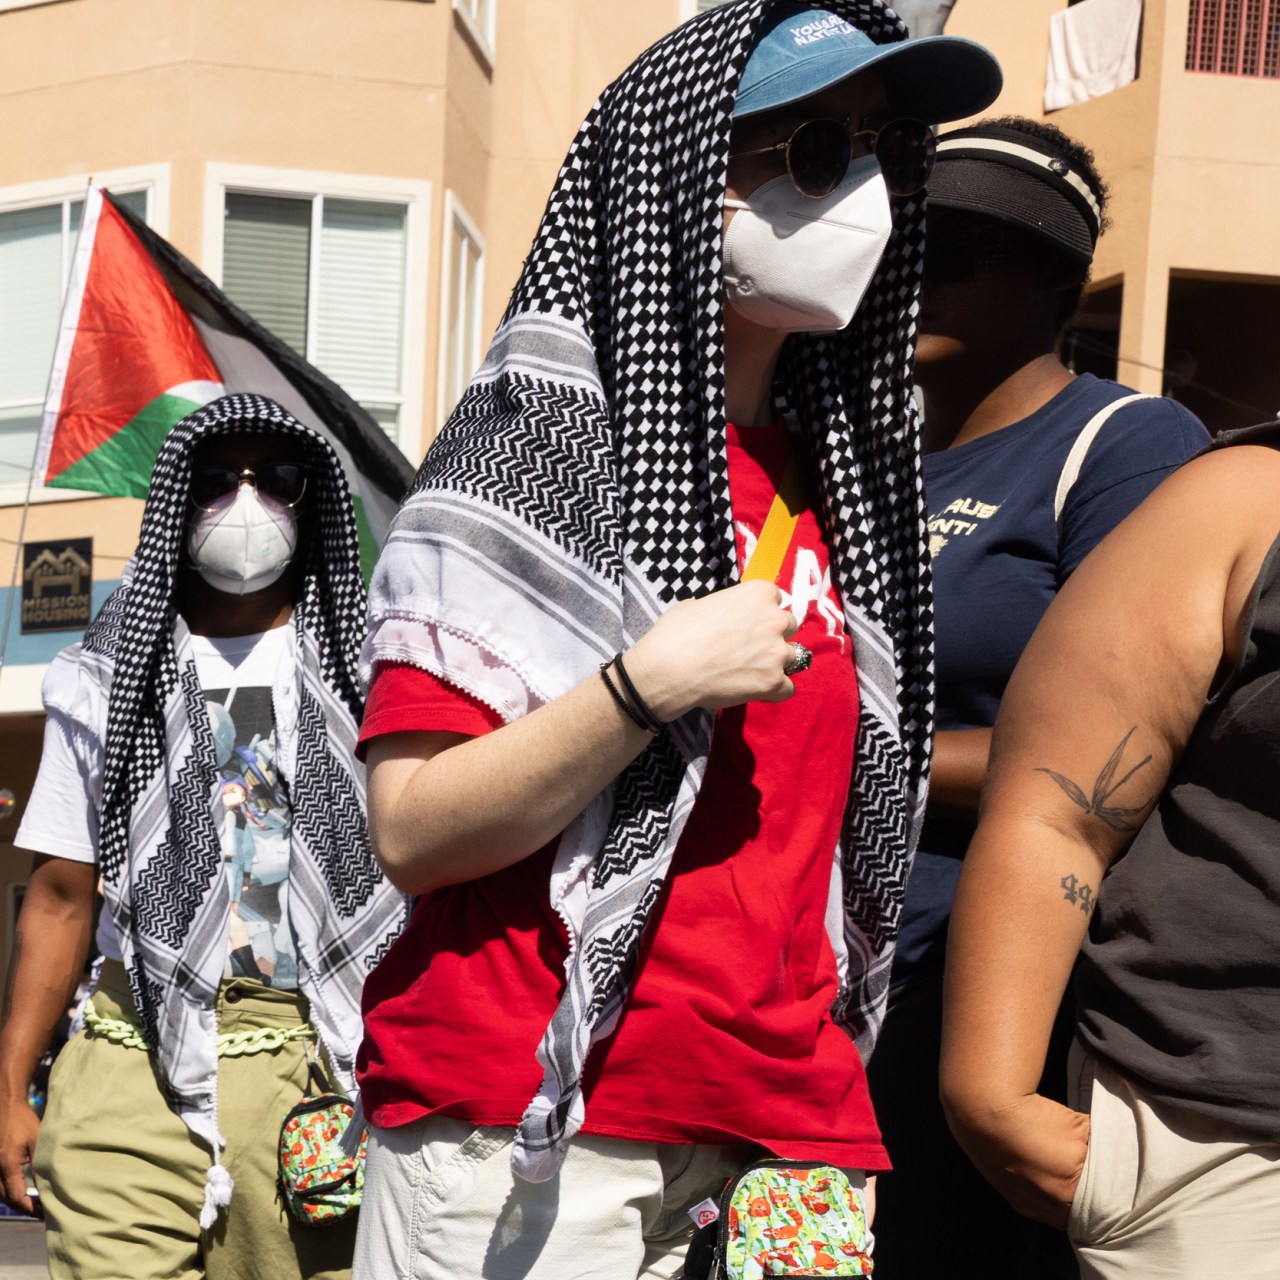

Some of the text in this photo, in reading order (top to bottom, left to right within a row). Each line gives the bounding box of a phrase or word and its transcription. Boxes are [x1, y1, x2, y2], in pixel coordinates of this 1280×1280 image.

[790, 21, 821, 38] YOU
[23, 594, 89, 610] MISSION
[22, 606, 88, 623] HOUSING
